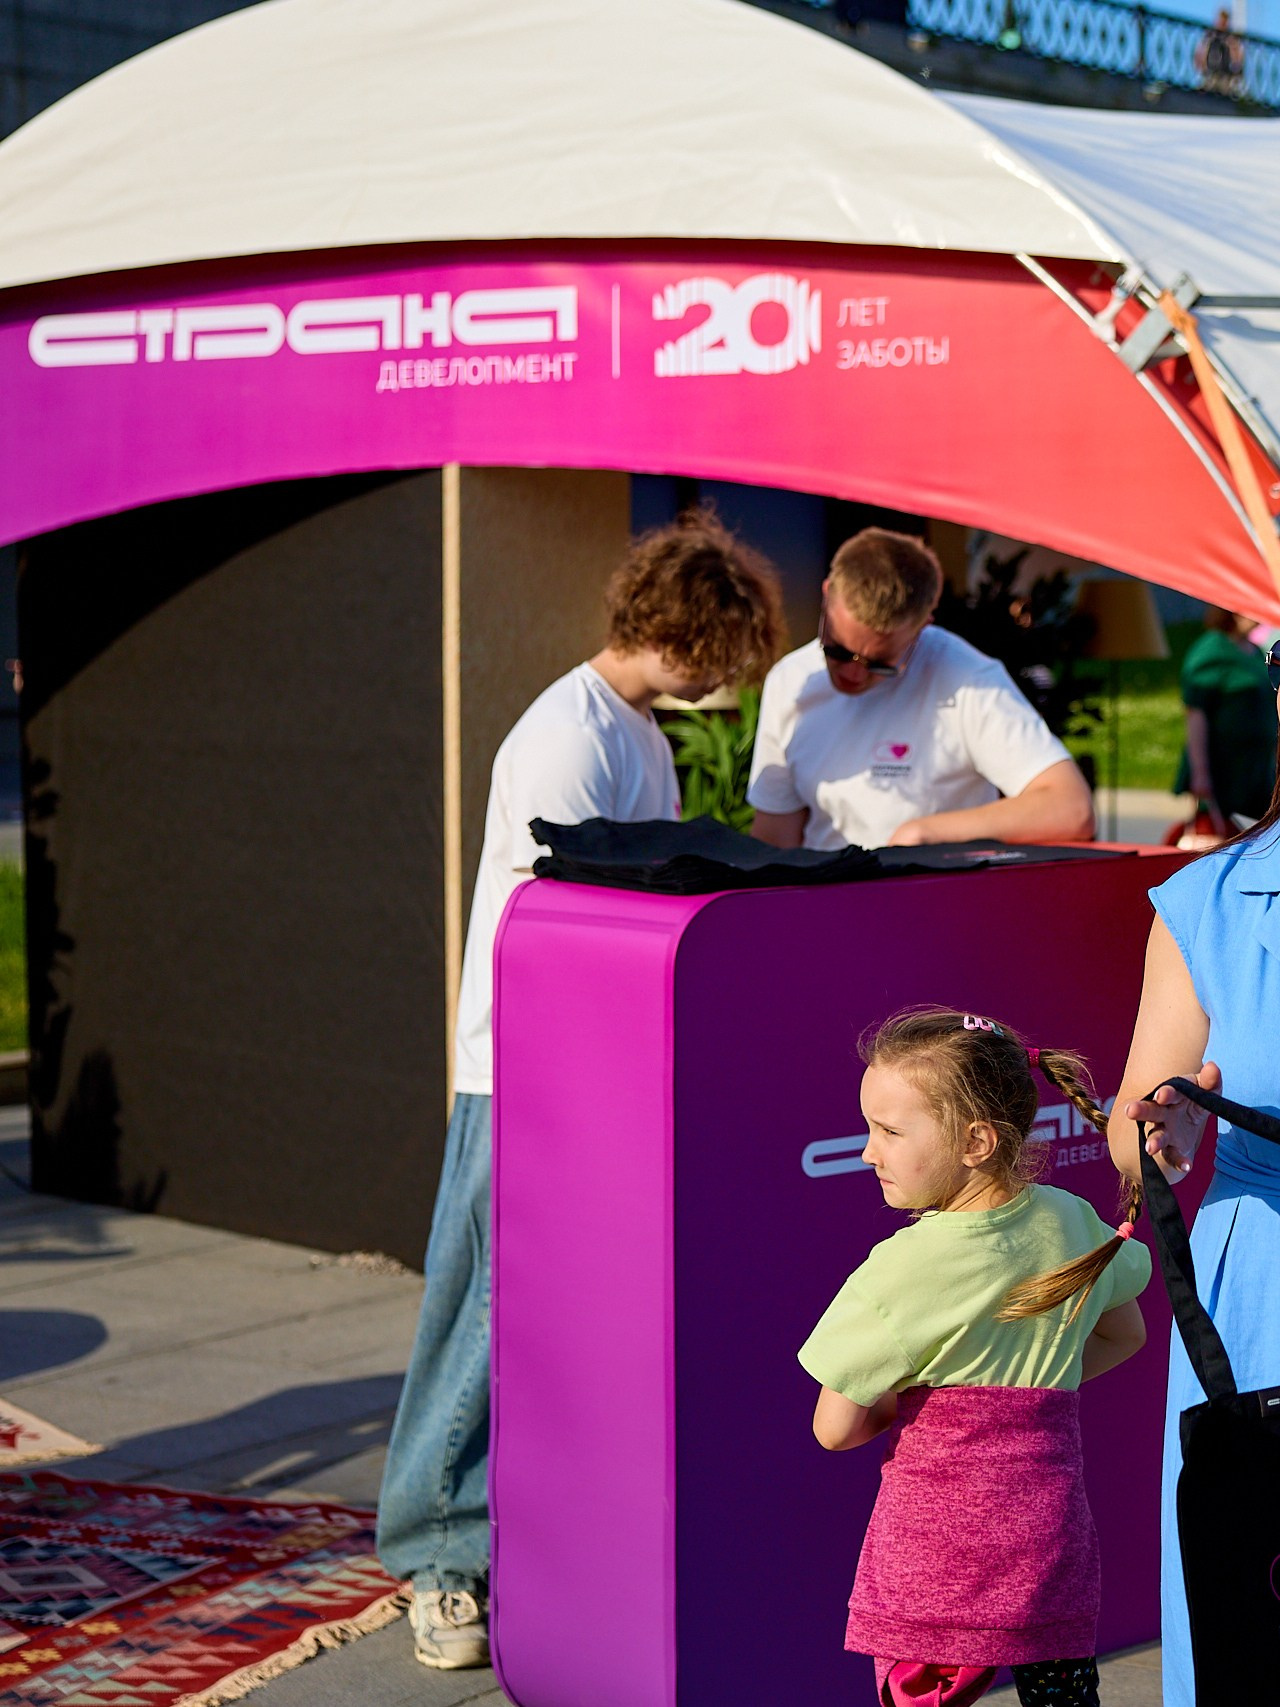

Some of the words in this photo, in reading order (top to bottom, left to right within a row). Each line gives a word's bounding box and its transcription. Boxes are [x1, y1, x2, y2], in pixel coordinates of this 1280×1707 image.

[652, 273, 821, 377] 20
[836, 297, 890, 327] ЛЕТ
[836, 335, 949, 370] ЗАБОТЫ
[376, 352, 578, 393] ДЕВЕЛОПМЕНТ
